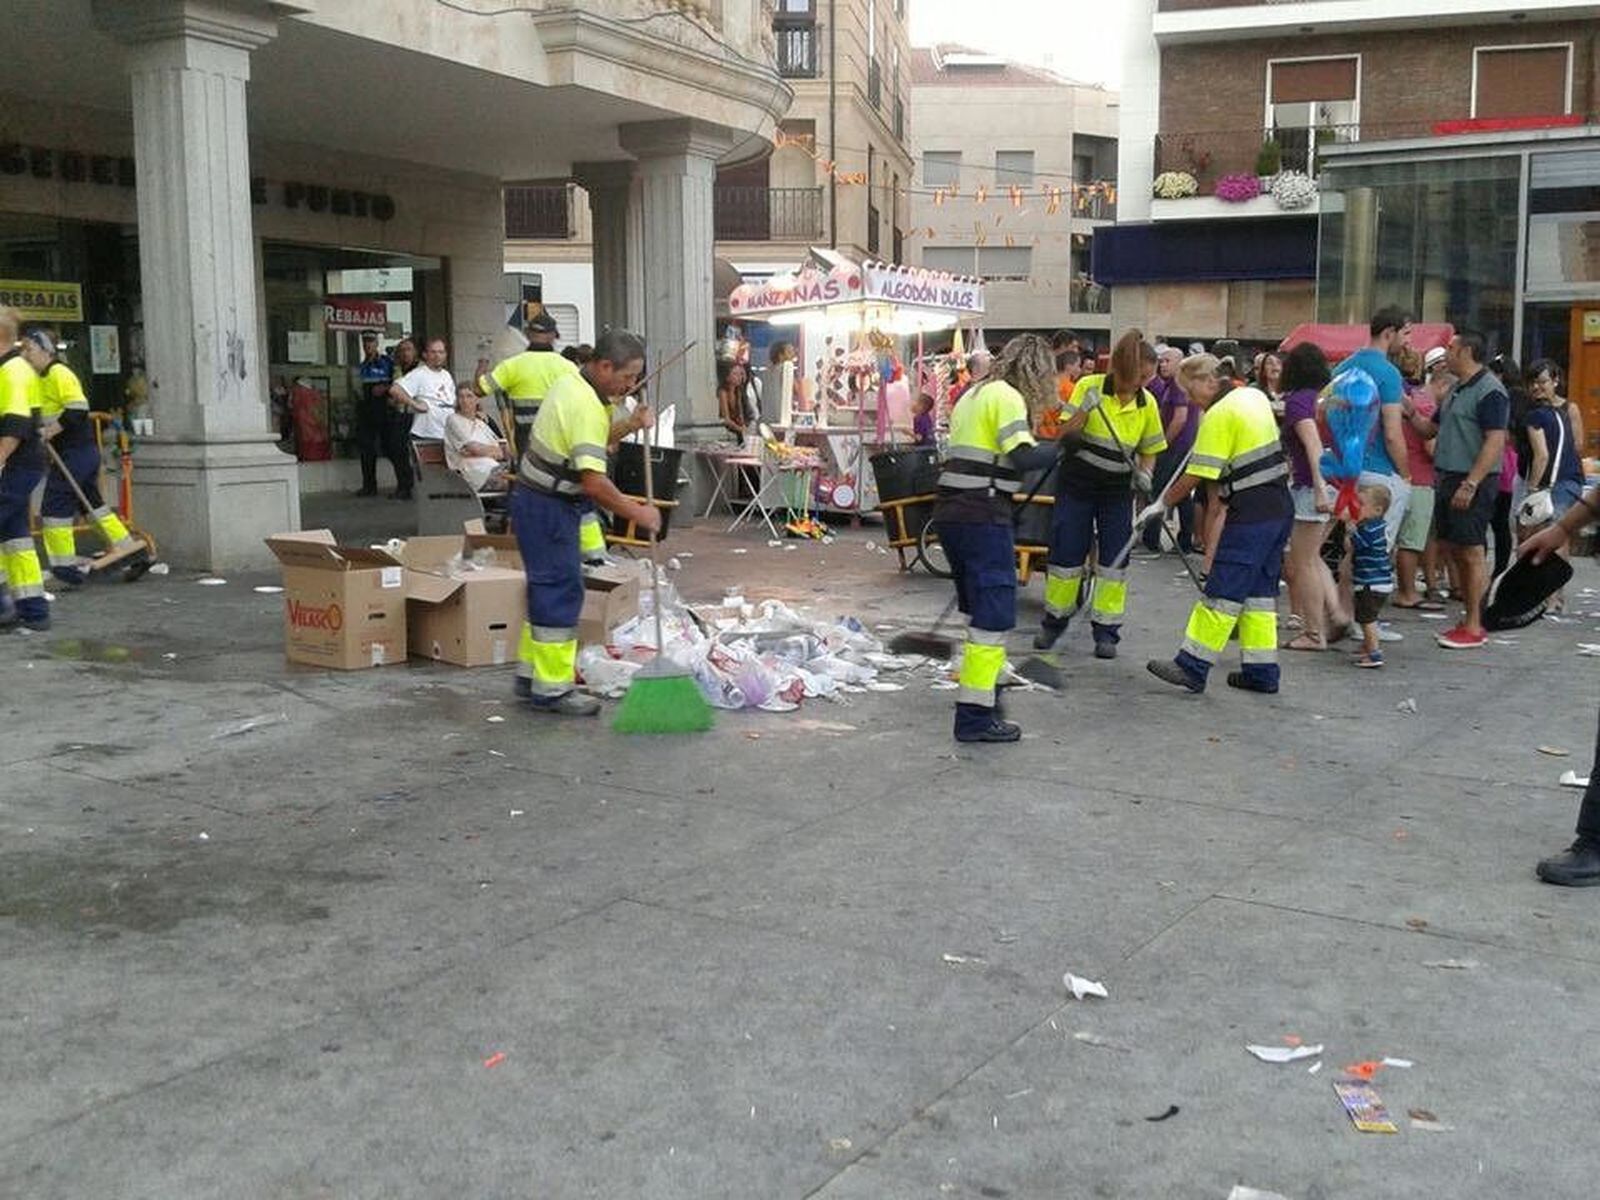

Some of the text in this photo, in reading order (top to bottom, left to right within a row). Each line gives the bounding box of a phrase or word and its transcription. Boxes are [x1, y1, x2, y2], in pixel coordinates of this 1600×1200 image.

[0, 291, 78, 309] REBAJAS
[747, 279, 841, 309] MANZANAS
[881, 280, 973, 308] ALGODÓN DULCE
[324, 304, 385, 325] REBAJAS
